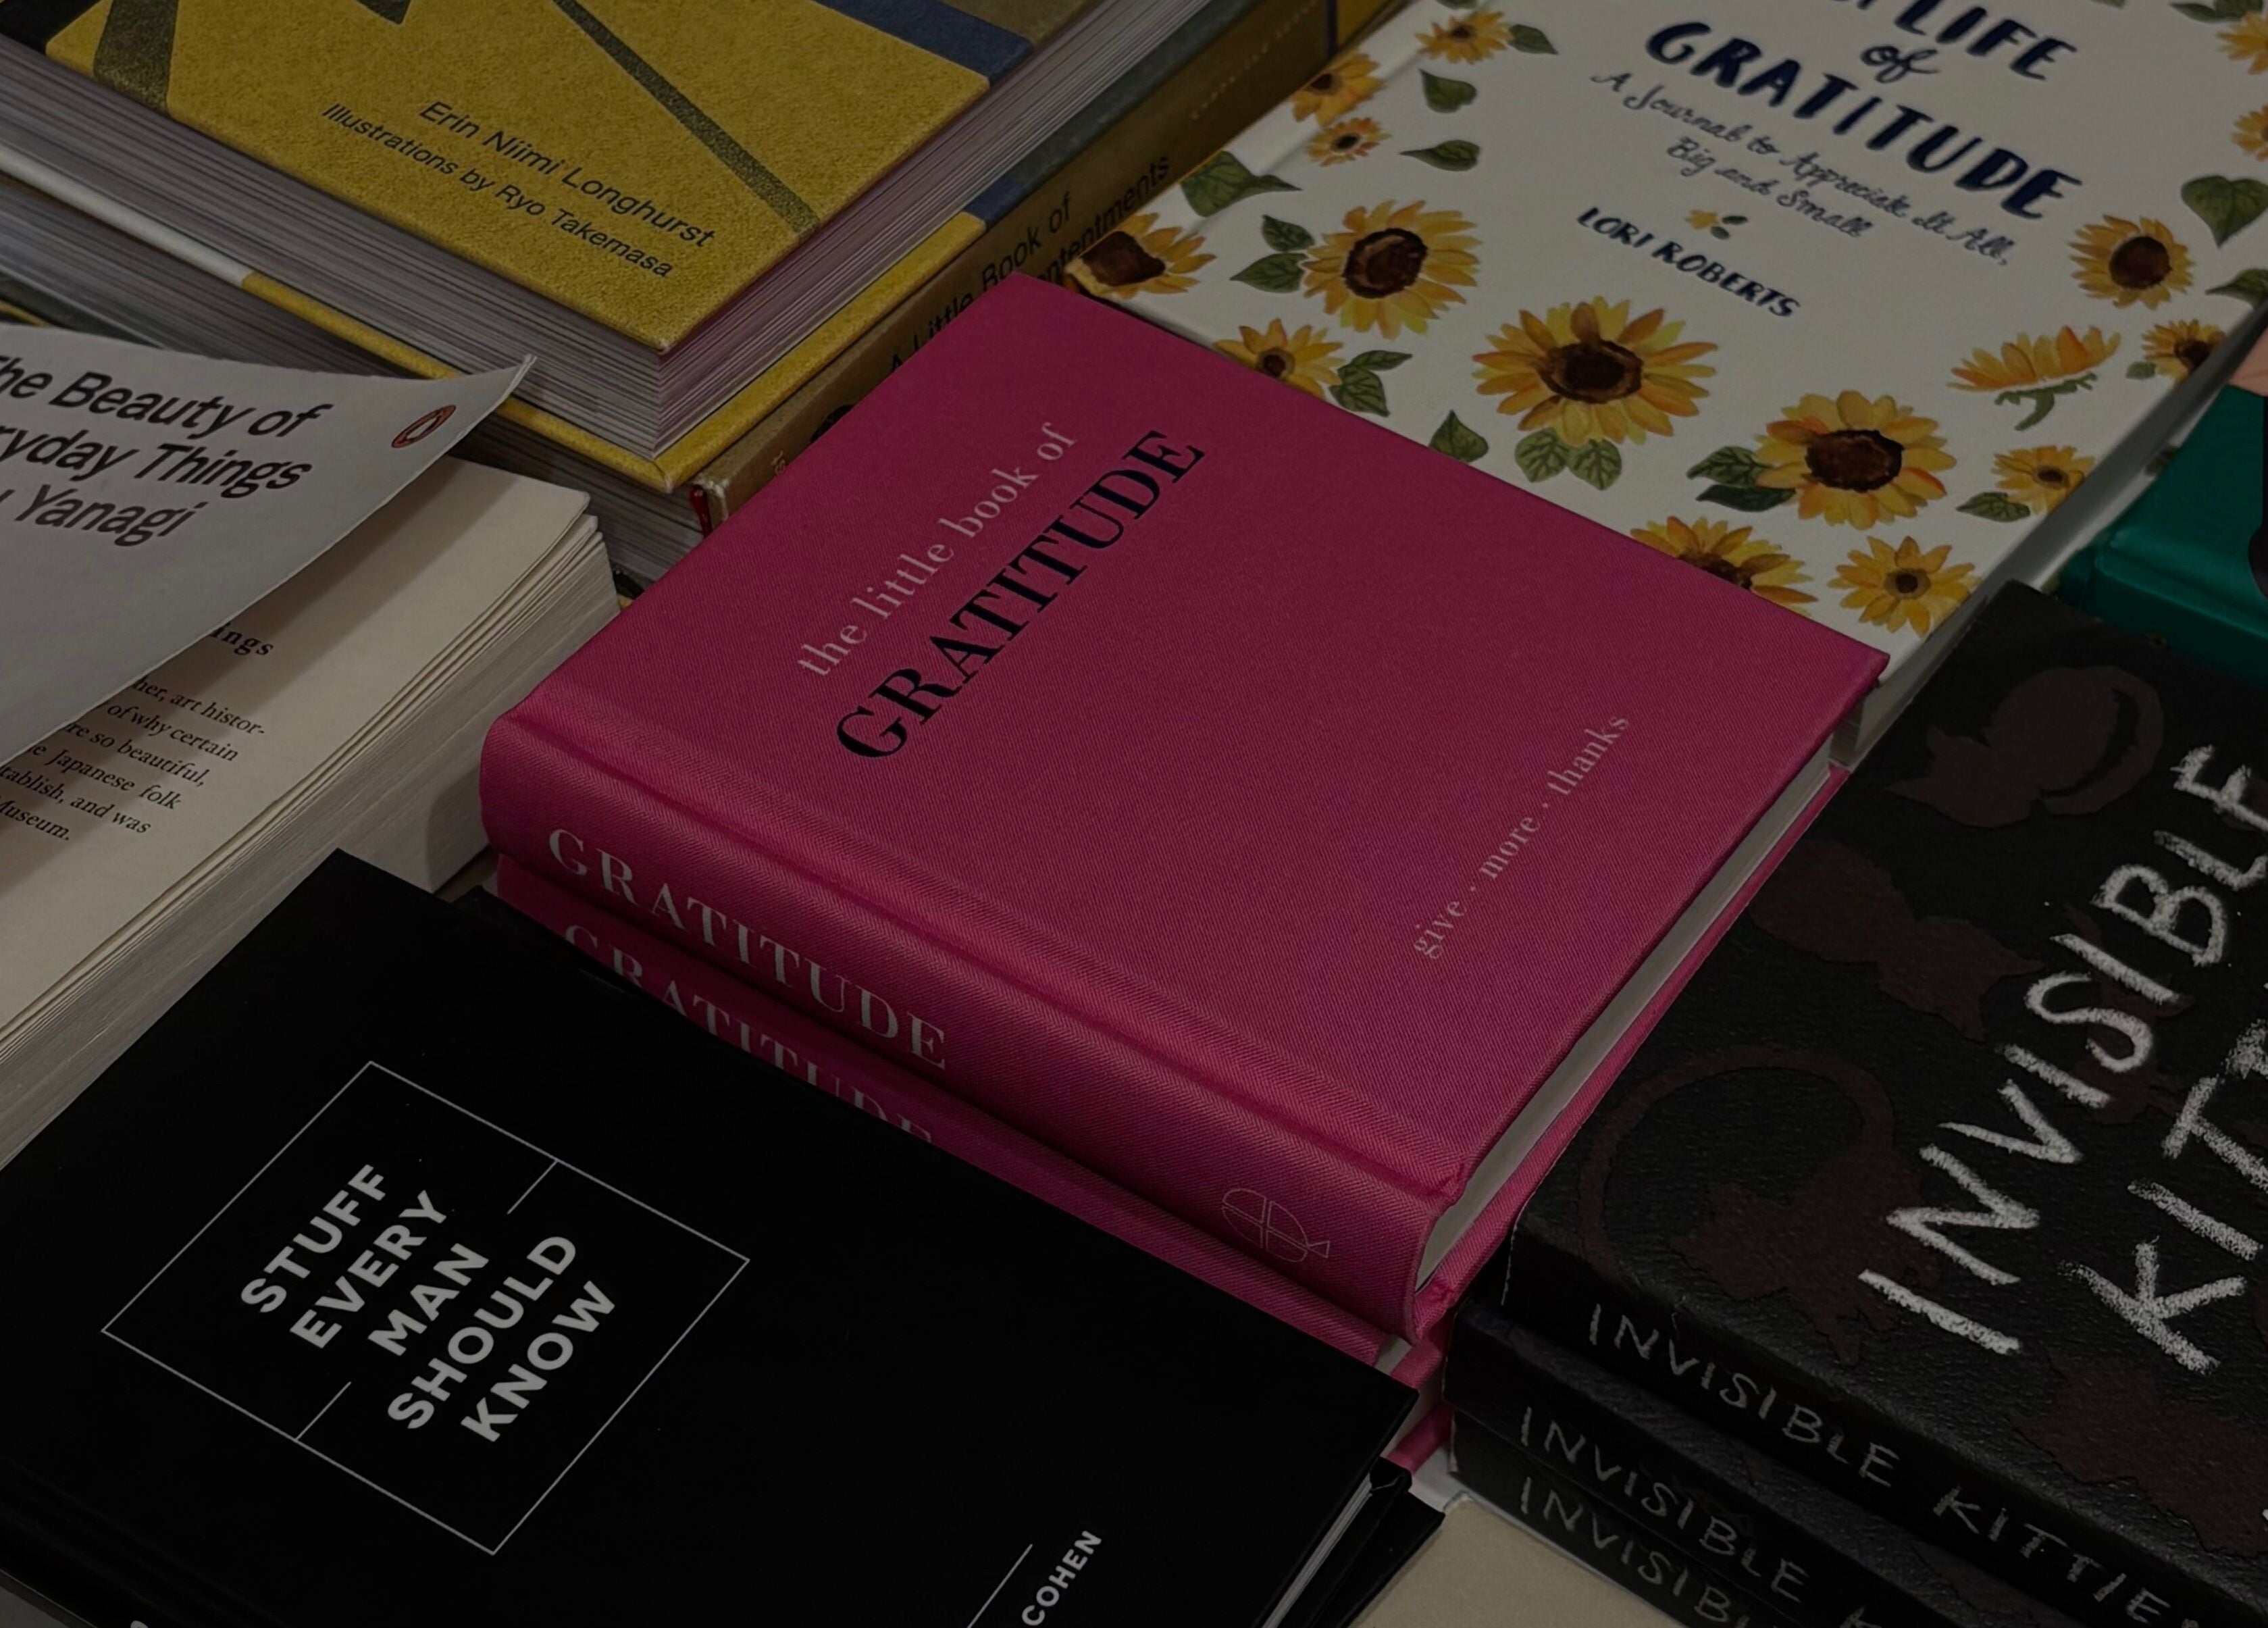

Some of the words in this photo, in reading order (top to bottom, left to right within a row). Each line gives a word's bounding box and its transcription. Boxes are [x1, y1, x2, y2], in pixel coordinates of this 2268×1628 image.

[1860, 45, 1940, 84] of
[1895, 0, 2078, 80] LIFE
[419, 101, 480, 138] Erin
[483, 130, 561, 176] Niimi
[561, 166, 715, 247] Longhurst
[1591, 72, 1632, 93] A
[1623, 85, 1750, 143] Journal
[1747, 135, 1781, 155] to
[1780, 152, 1911, 219] Appreciate
[1911, 211, 1950, 240] It
[1946, 227, 2016, 266] All,
[1645, 21, 2082, 220] GRATITUDE
[322, 103, 458, 175] Illustrations
[460, 168, 495, 192] by
[495, 184, 545, 217] Ryo
[552, 208, 673, 278] Takemasa
[983, 226, 1041, 292] Book
[1050, 191, 1070, 234] of
[1037, 156, 1169, 286] ntentments
[1666, 136, 1716, 177] Big
[1714, 166, 1774, 197] and
[1777, 189, 1875, 238] Small
[1577, 207, 1653, 249] LORI
[1653, 240, 1802, 317] ROBERTS
[49, 372, 257, 439] Beauty
[248, 404, 334, 437] of
[15, 484, 208, 547] Yanagi
[134, 443, 313, 499] Things
[798, 624, 867, 677] the
[851, 544, 954, 620] little
[938, 467, 1039, 541] book
[1036, 422, 1078, 462] of
[836, 430, 1205, 759] GRATITUDE
[45, 749, 135, 792] Japanese
[139, 785, 182, 810] folk
[90, 733, 115, 748] so
[118, 740, 211, 787] beautiful,
[107, 705, 139, 718] of
[132, 713, 172, 737] why
[170, 729, 238, 762] certain
[170, 694, 203, 713] art
[201, 701, 265, 735] histor-
[70, 797, 115, 818] and
[113, 812, 151, 834] was
[1413, 900, 1468, 960] give
[1478, 817, 1541, 880] more
[1547, 716, 1629, 796] thanks
[548, 828, 946, 1069] GRATITUDE
[1857, 744, 2268, 1354] INVISIBLE
[240, 1163, 387, 1314] STUFF
[288, 1189, 448, 1350] EVERY
[367, 1242, 490, 1357] MAN
[387, 1236, 577, 1430] SHOULD
[460, 1280, 616, 1443] KNOW
[1520, 1406, 1810, 1604] INVISIBLE
[1589, 1303, 1901, 1487] INVISIBLE
[1932, 1485, 2200, 1628] KITTIE
[1021, 1529, 1103, 1627] COHEN
